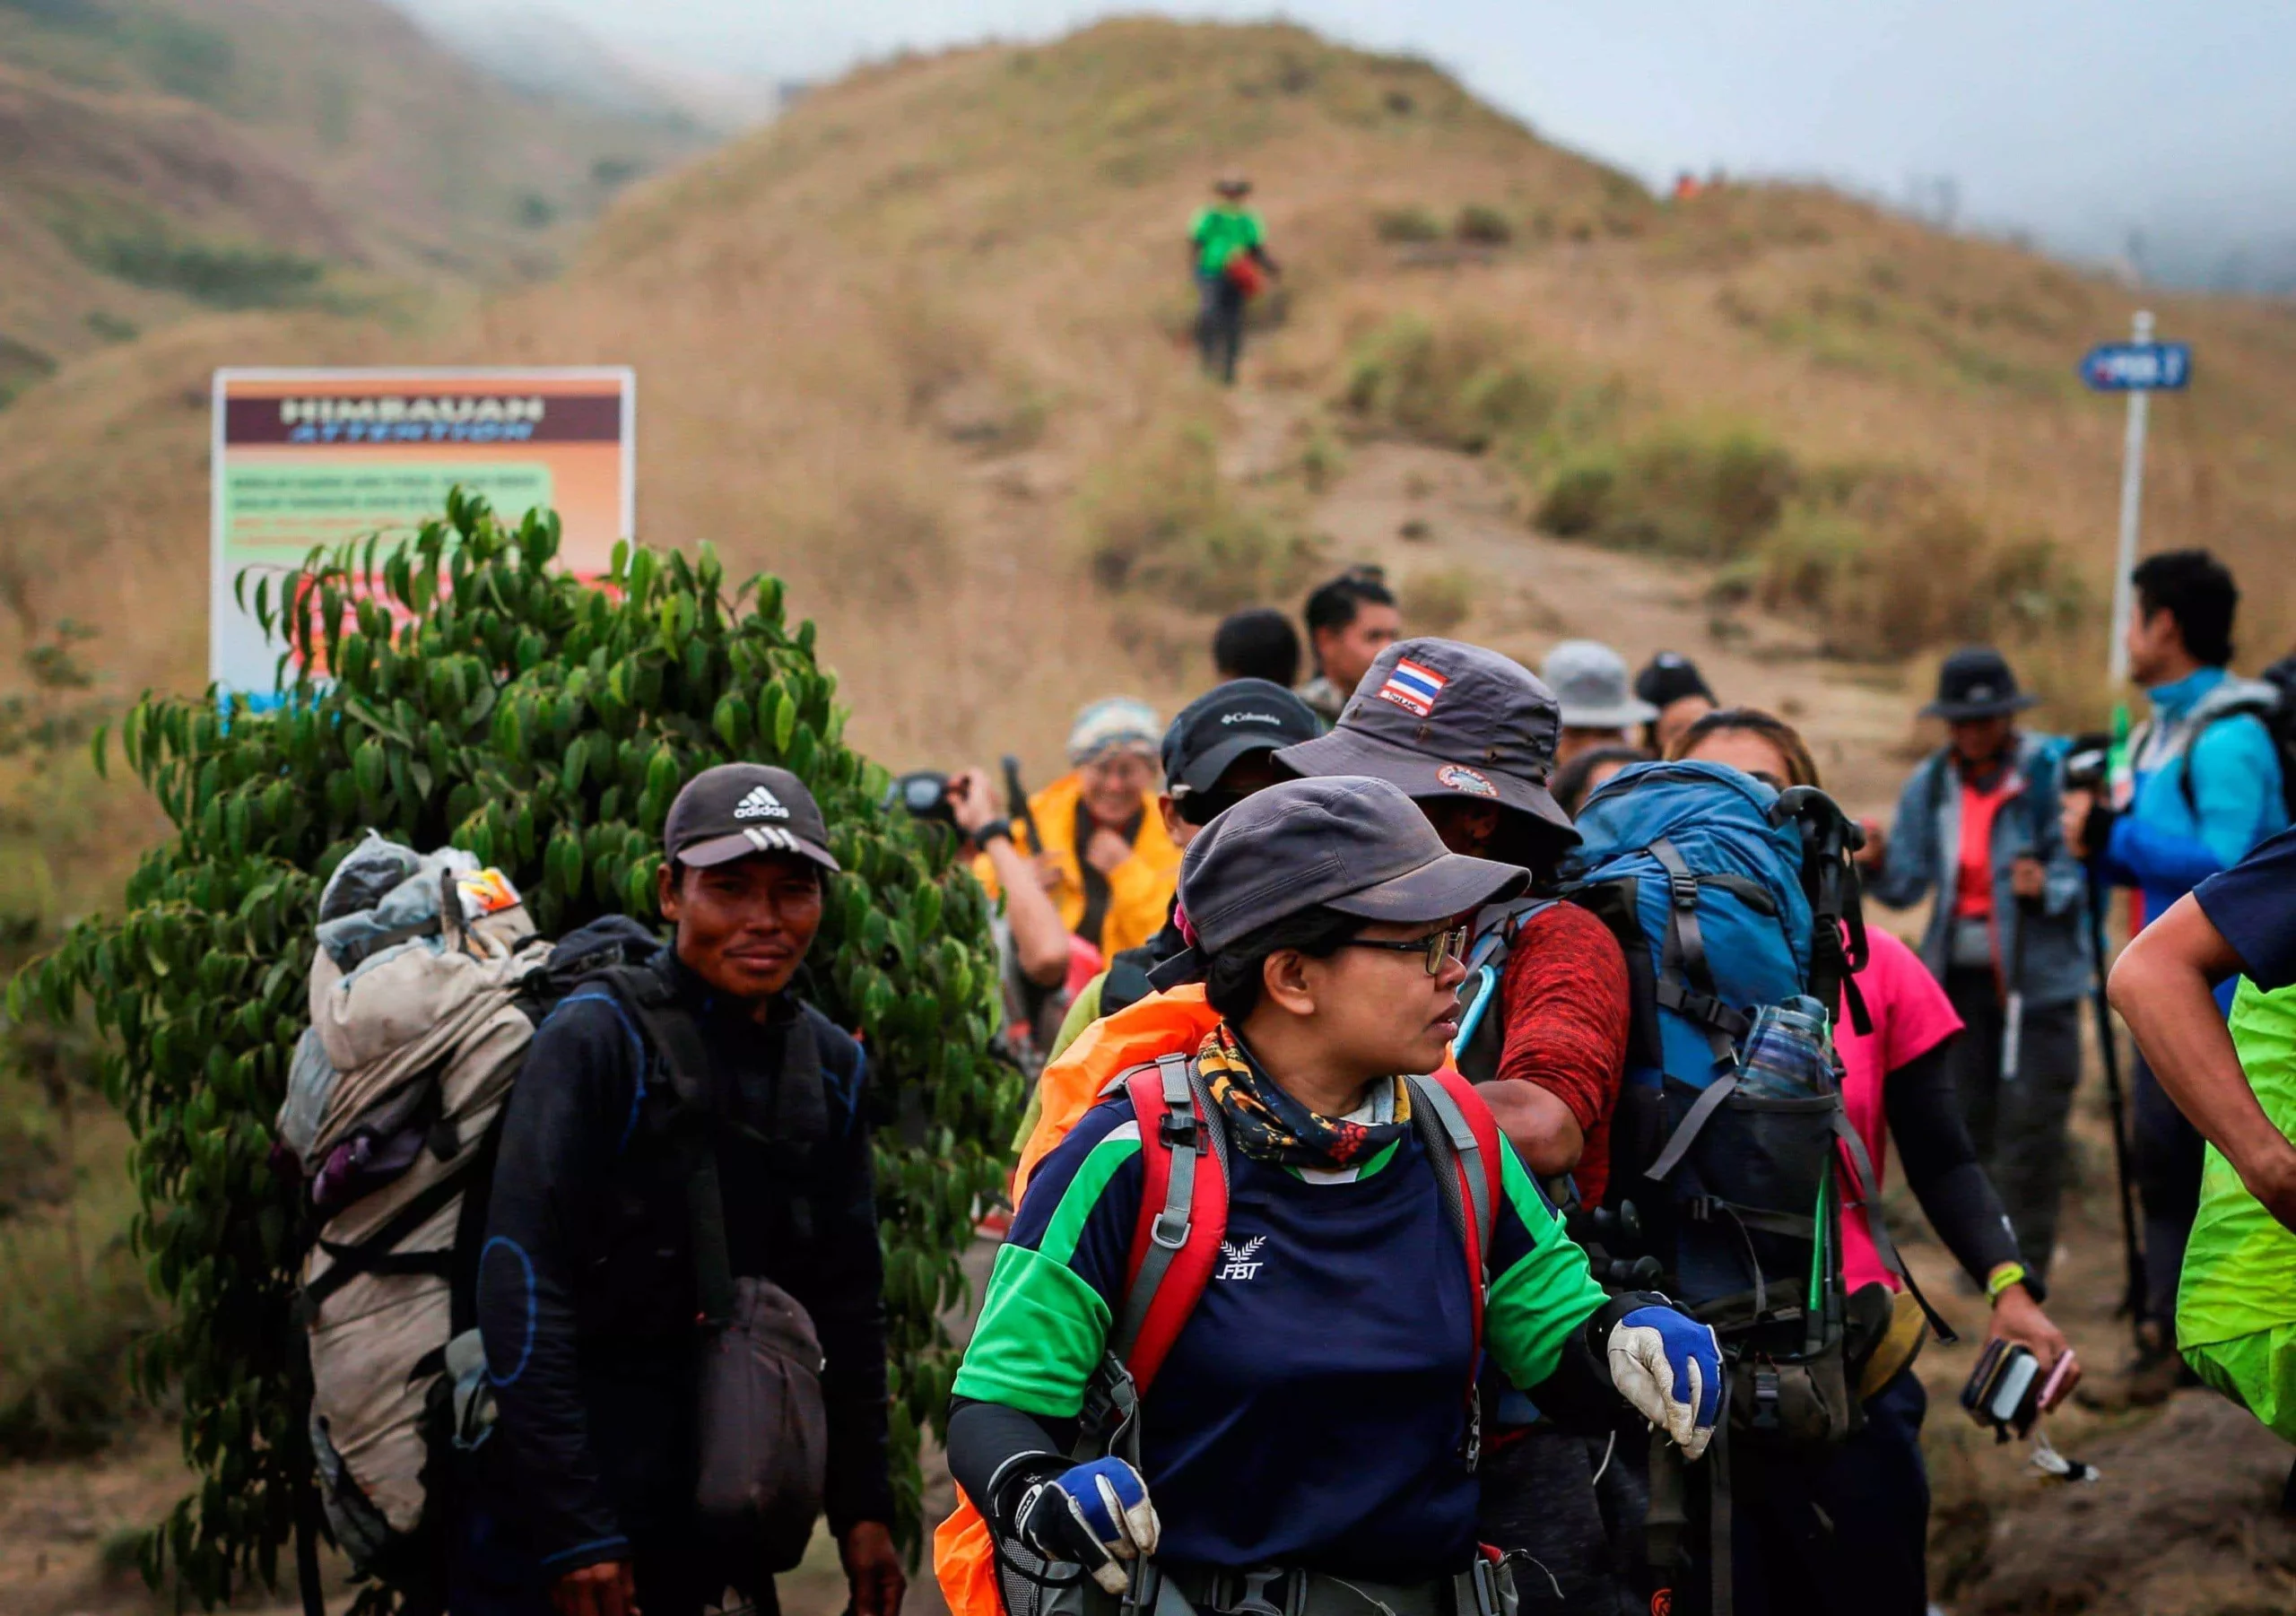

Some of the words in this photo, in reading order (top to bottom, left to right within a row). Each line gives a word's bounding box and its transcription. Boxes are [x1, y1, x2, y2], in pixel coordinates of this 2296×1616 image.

[280, 396, 545, 422] HIMBAUAN
[290, 421, 536, 443] ATTENTION
[1388, 692, 1419, 710] THAILAND
[1233, 712, 1282, 725] Columbia
[734, 804, 790, 819] adidas
[1215, 1262, 1265, 1280] FBT
